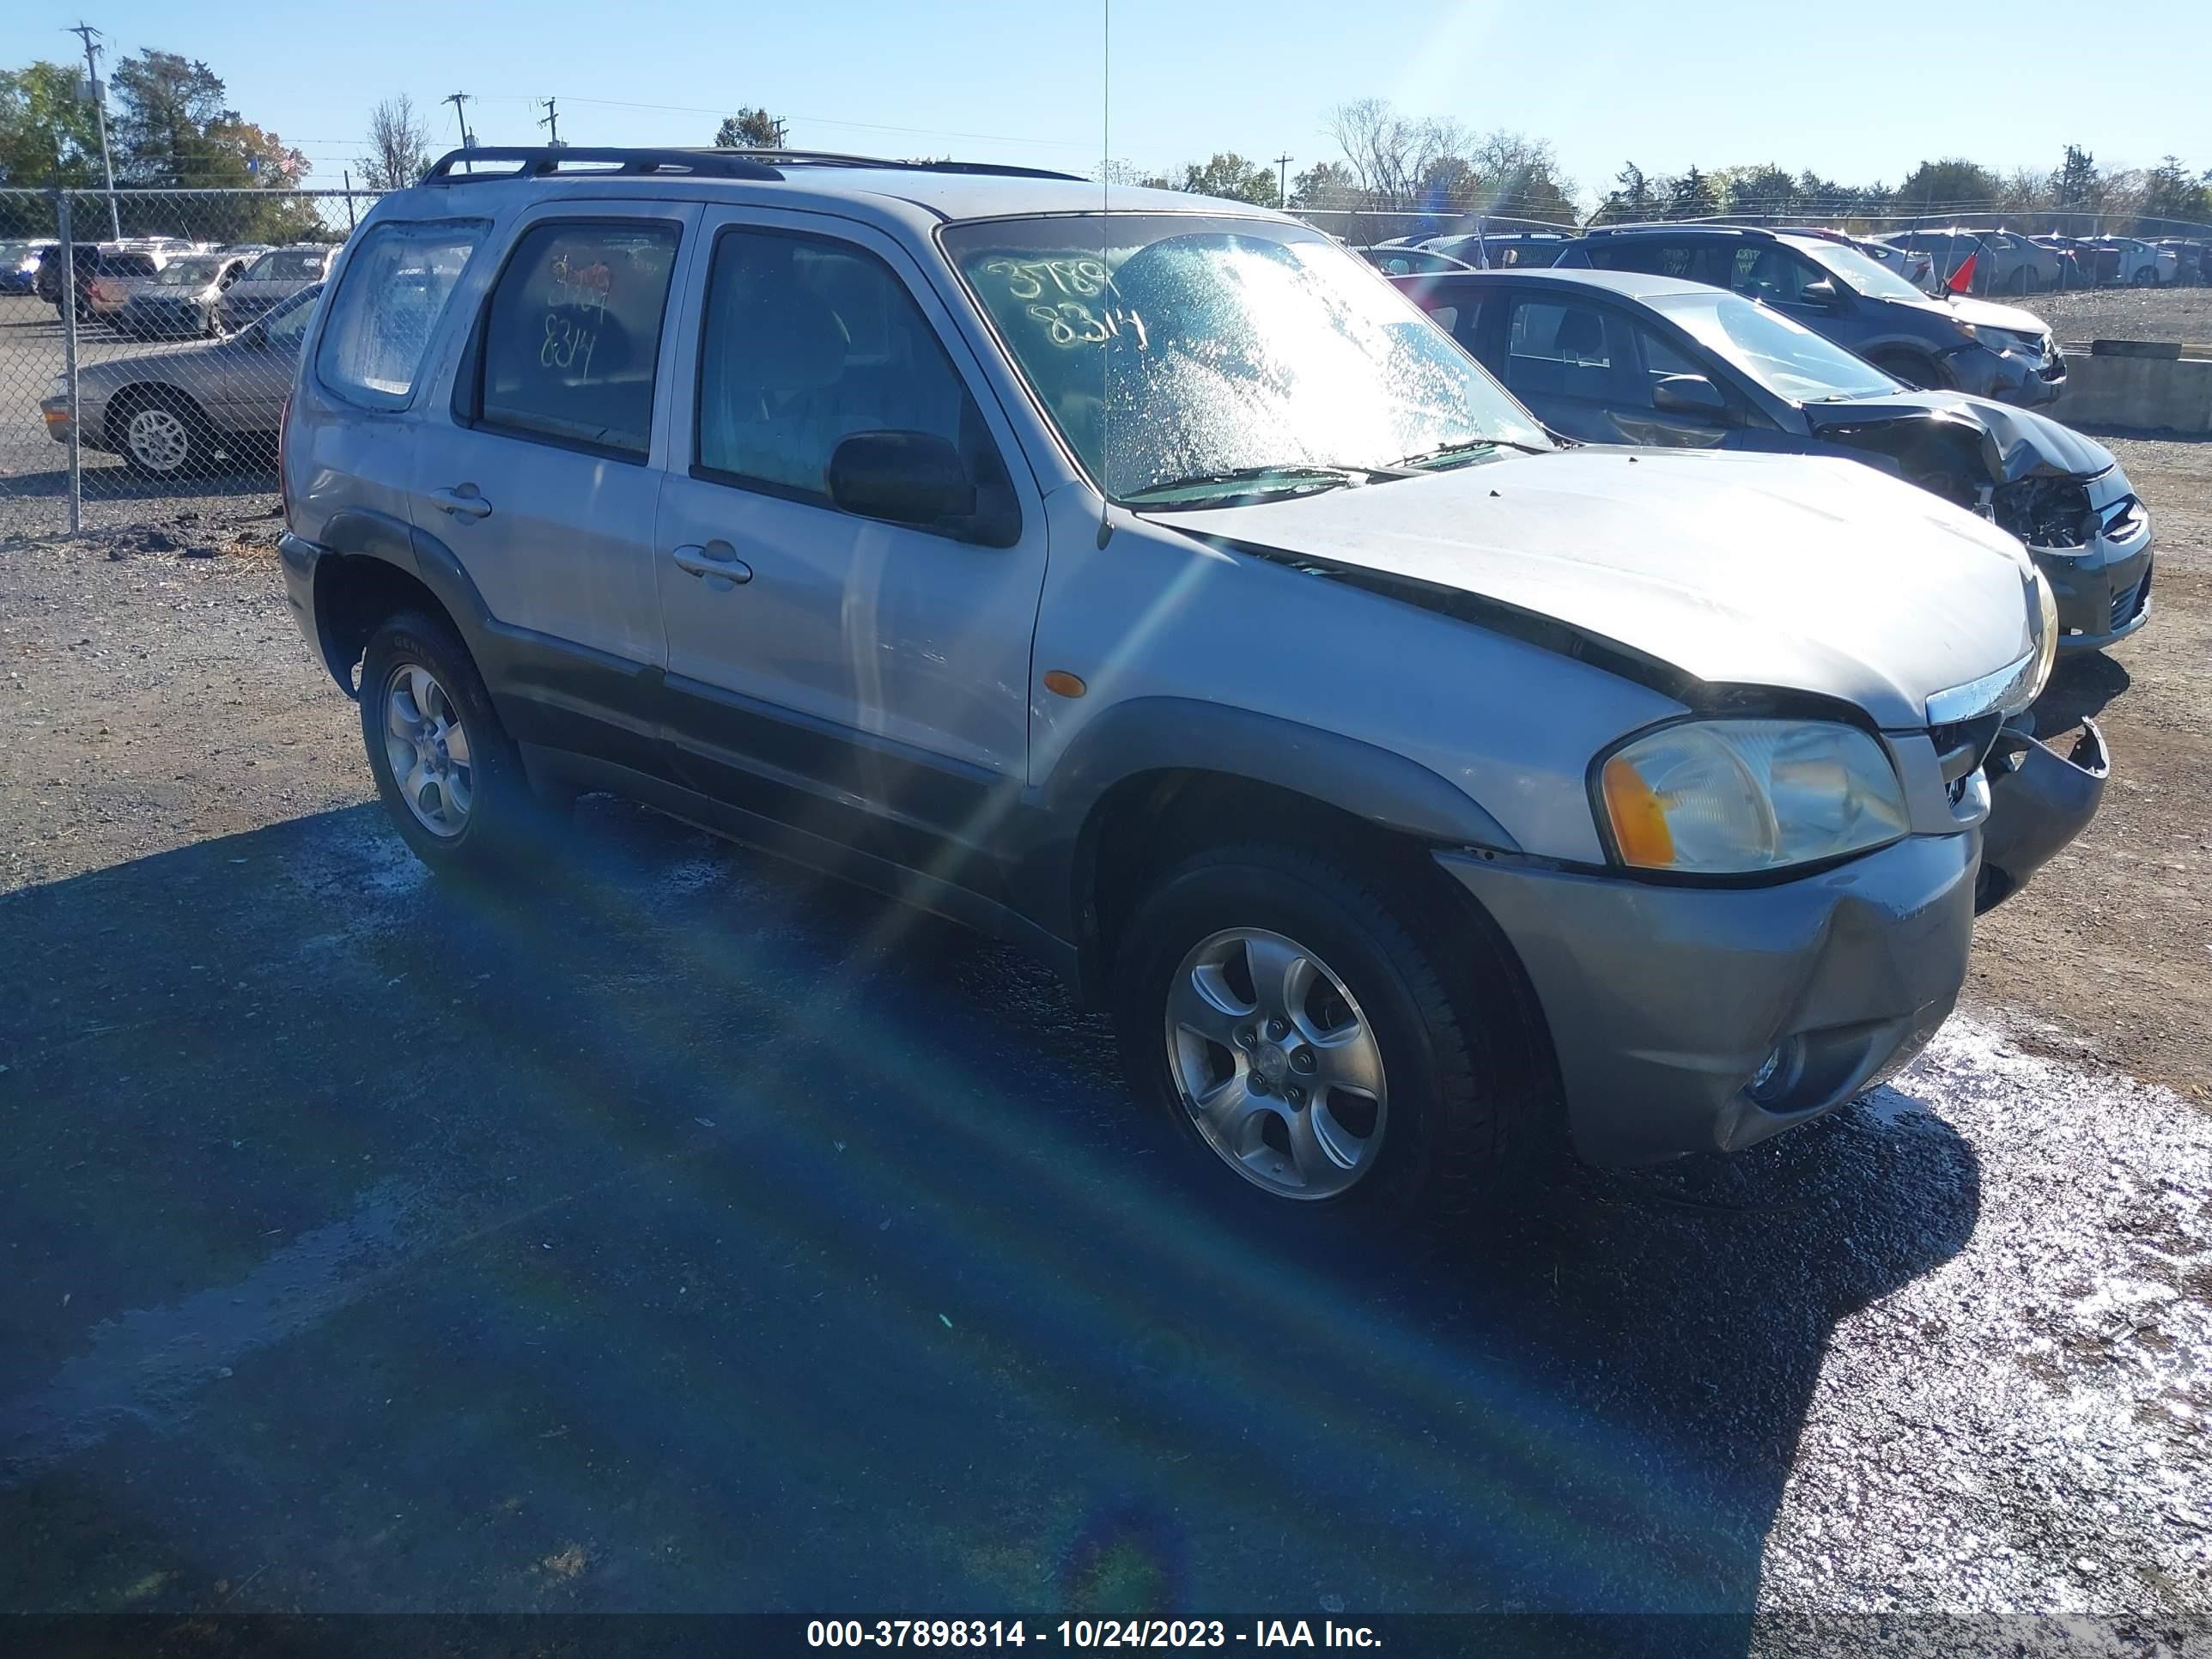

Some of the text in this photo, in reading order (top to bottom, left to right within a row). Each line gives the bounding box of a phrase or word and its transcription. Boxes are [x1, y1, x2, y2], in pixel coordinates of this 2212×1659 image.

[987, 260, 1121, 299] 3789
[540, 313, 596, 379] 8314
[1030, 301, 1149, 350] 8314
